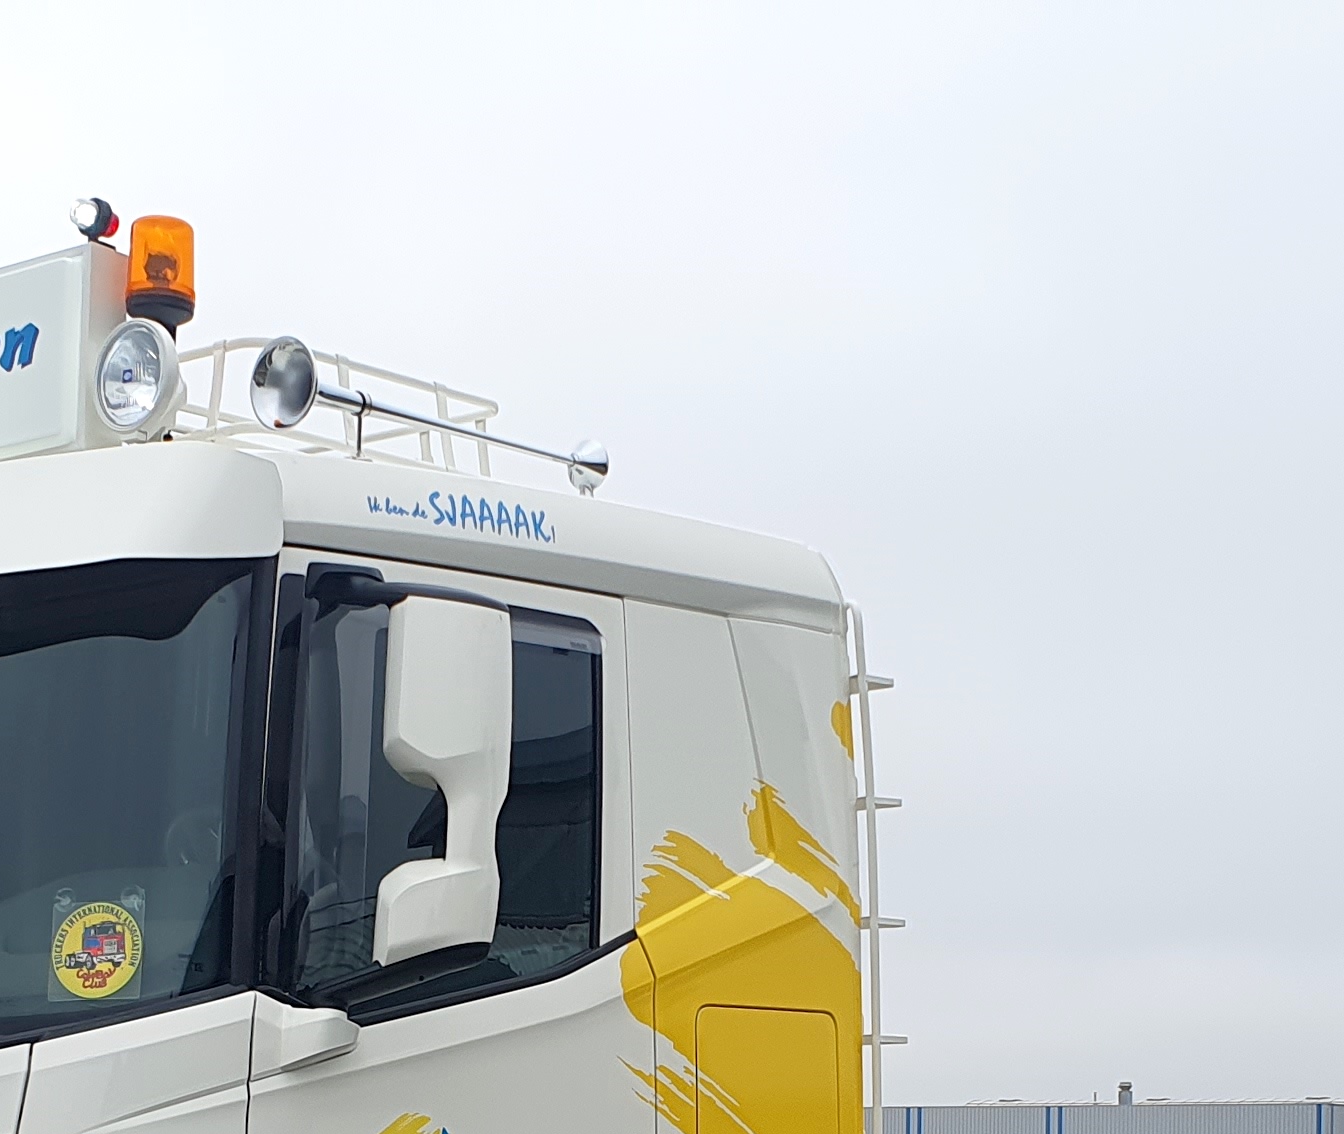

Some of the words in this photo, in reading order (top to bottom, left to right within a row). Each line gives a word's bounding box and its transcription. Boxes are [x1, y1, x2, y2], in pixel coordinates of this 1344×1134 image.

[411, 502, 428, 519] de
[66, 904, 124, 928] INTERNATIONAL
[124, 916, 139, 968] ASSOCIATION
